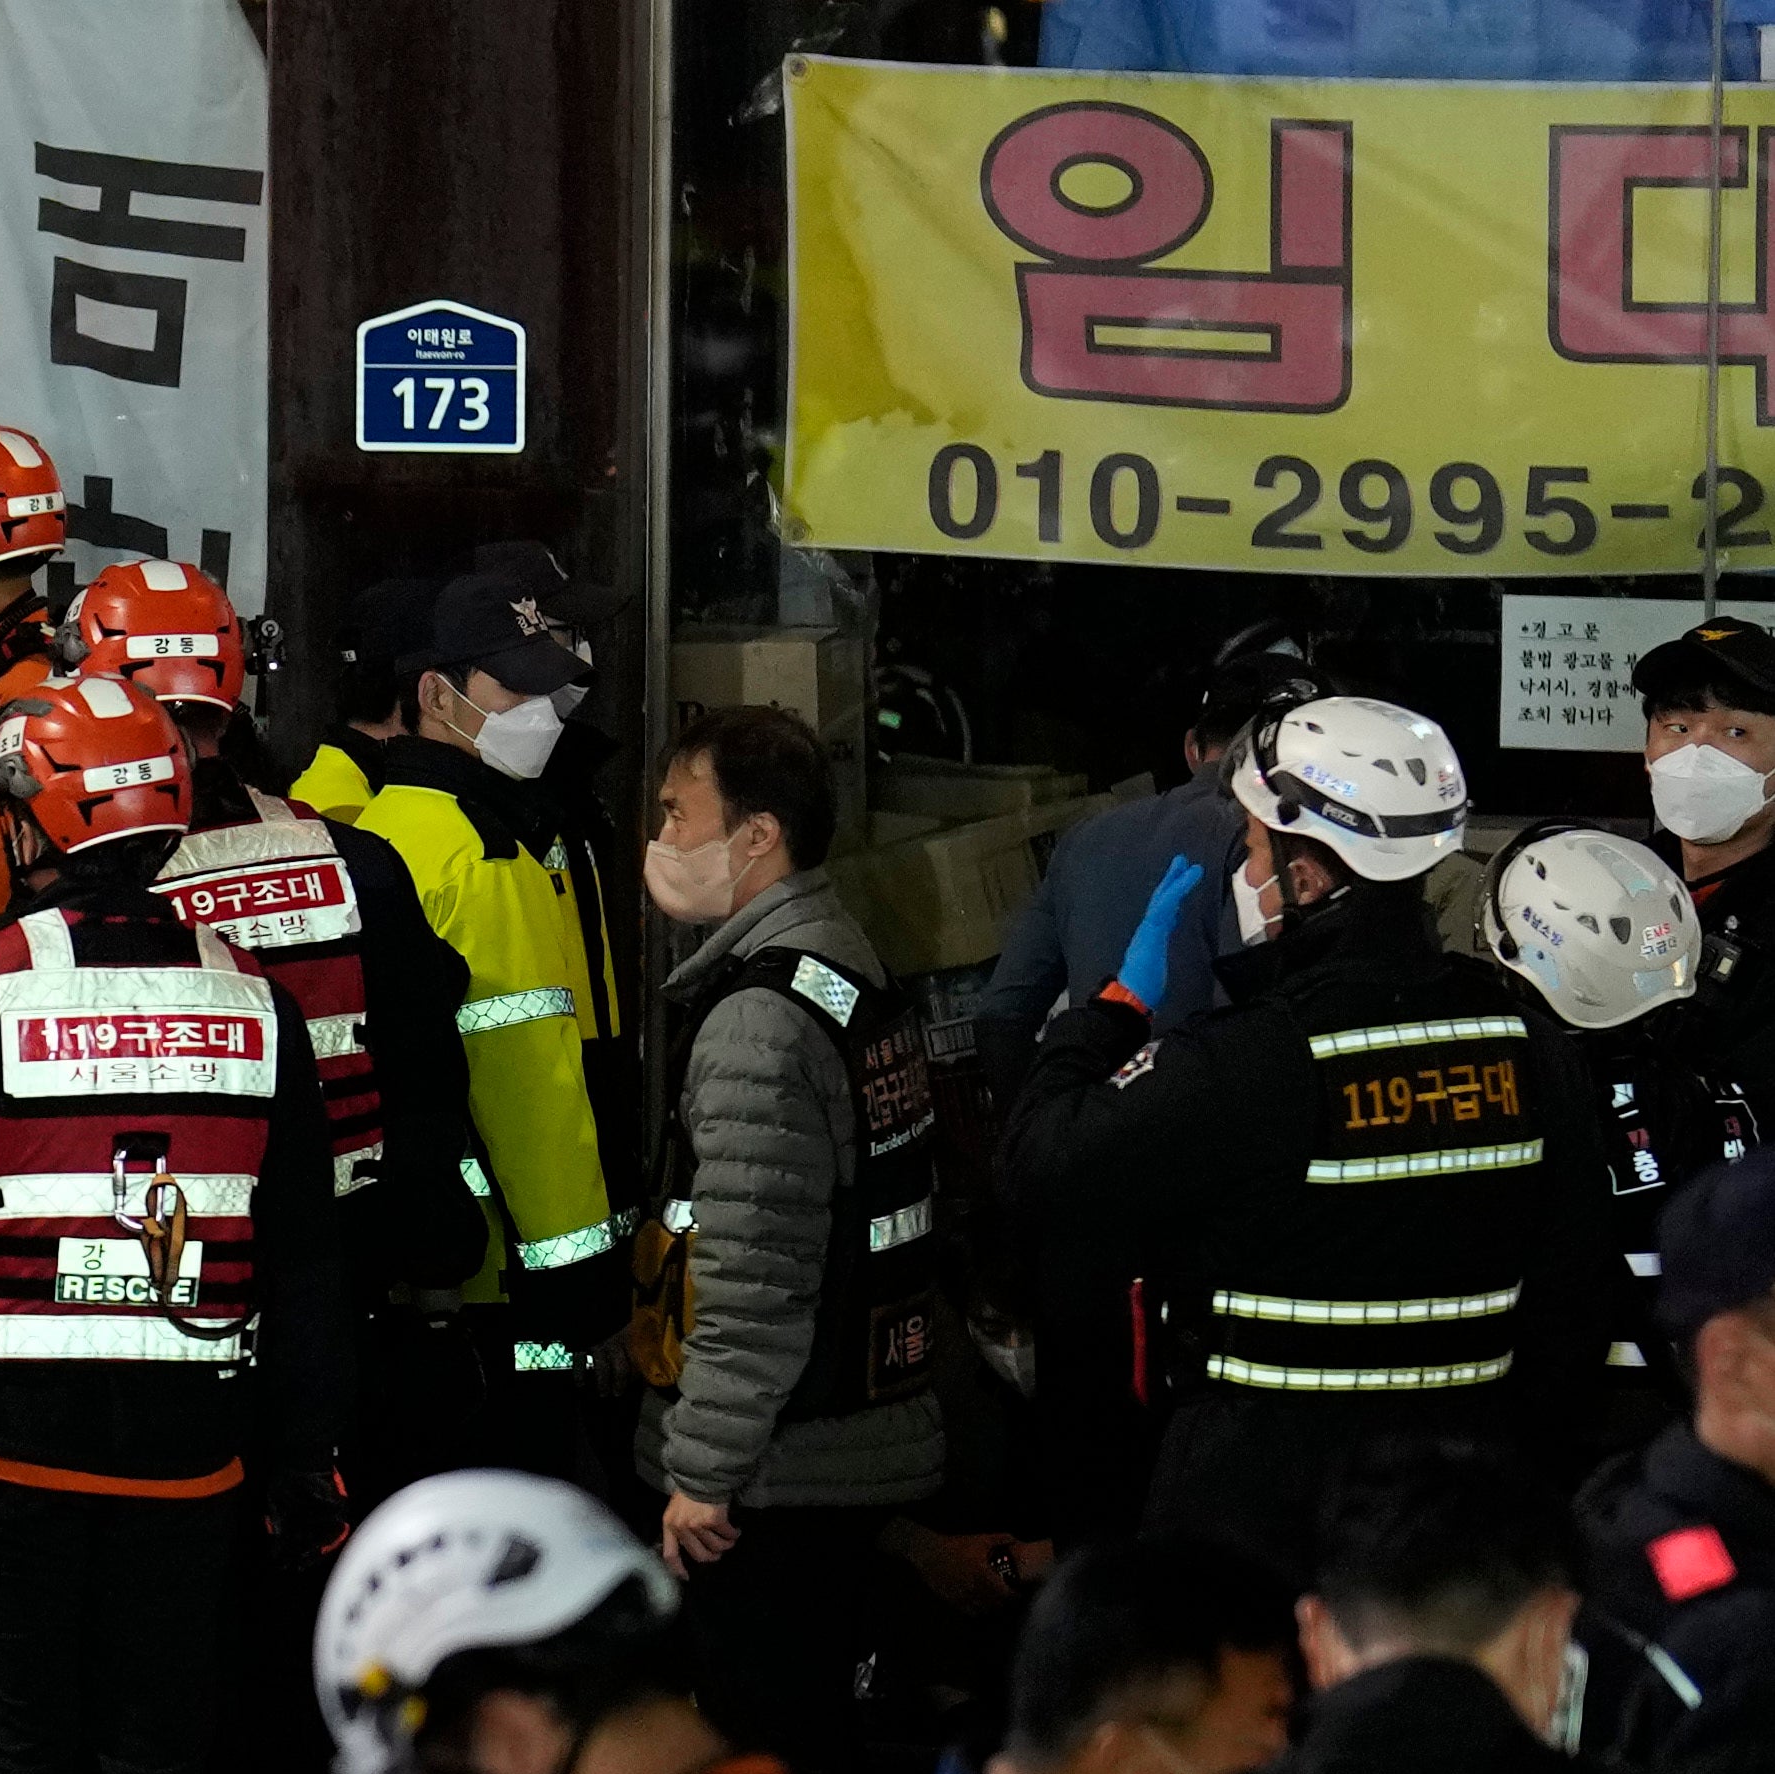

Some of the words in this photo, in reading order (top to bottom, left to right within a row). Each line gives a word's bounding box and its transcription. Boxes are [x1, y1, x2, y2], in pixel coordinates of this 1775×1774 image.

[407, 328, 474, 348] 이태원로
[415, 348, 467, 360] Itaewon-ro
[392, 377, 490, 431] 173
[153, 637, 195, 654] 강동
[1520, 650, 1551, 669] 불법
[1563, 651, 1614, 671] 광고물
[112, 762, 154, 786] 강동
[41, 1017, 246, 1054] 119구조대
[69, 1061, 220, 1086] 서울소방
[1342, 1058, 1520, 1130] 119구급대
[82, 1244, 106, 1271] 강
[62, 1276, 192, 1303] RESCE
